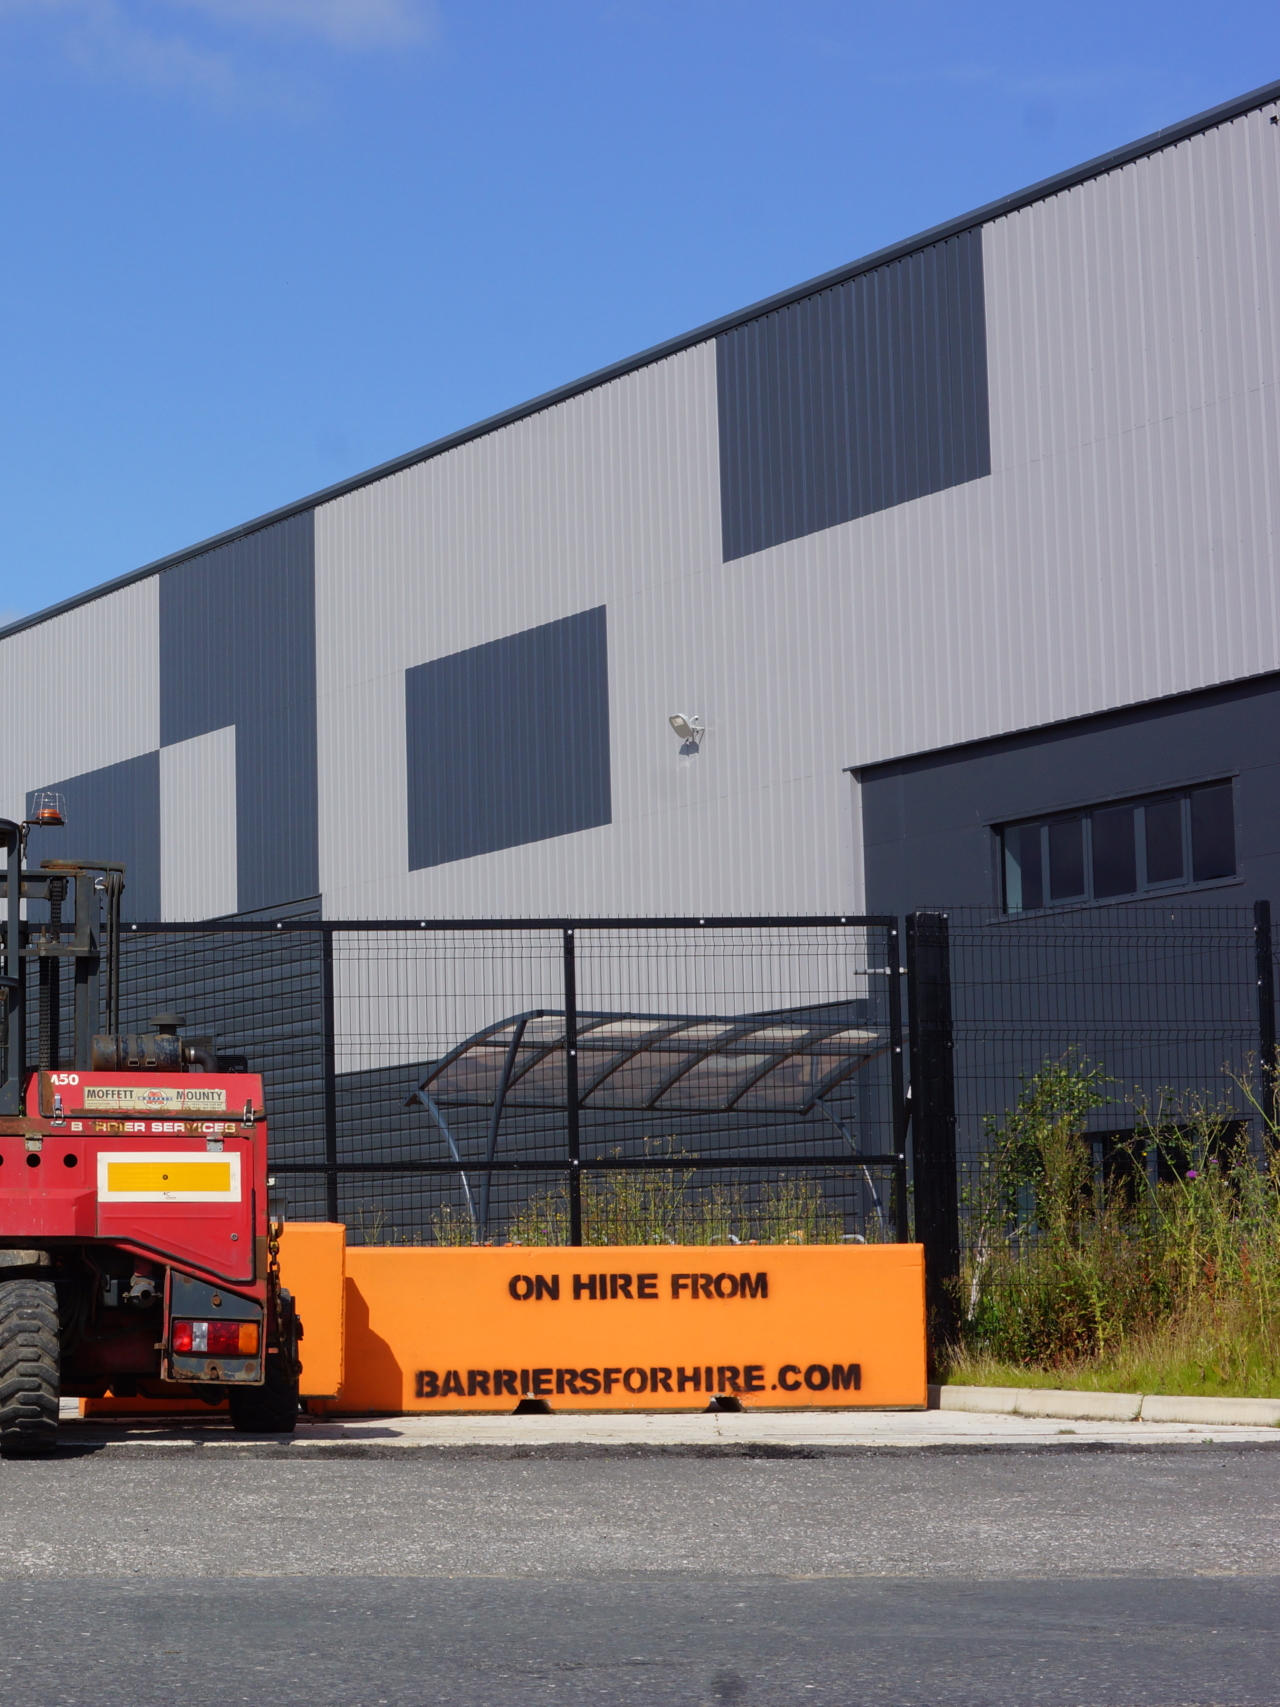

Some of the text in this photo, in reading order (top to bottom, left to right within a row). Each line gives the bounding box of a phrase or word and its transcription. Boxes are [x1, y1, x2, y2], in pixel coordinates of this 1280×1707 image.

[86, 1089, 223, 1101] MOFFETT MOUNTY
[71, 1121, 146, 1132] BRRIER
[151, 1122, 236, 1133] SERVICES
[509, 1272, 768, 1301] ON HIRE FROM
[415, 1363, 862, 1398] BARRIERSFORHIRE.COM
